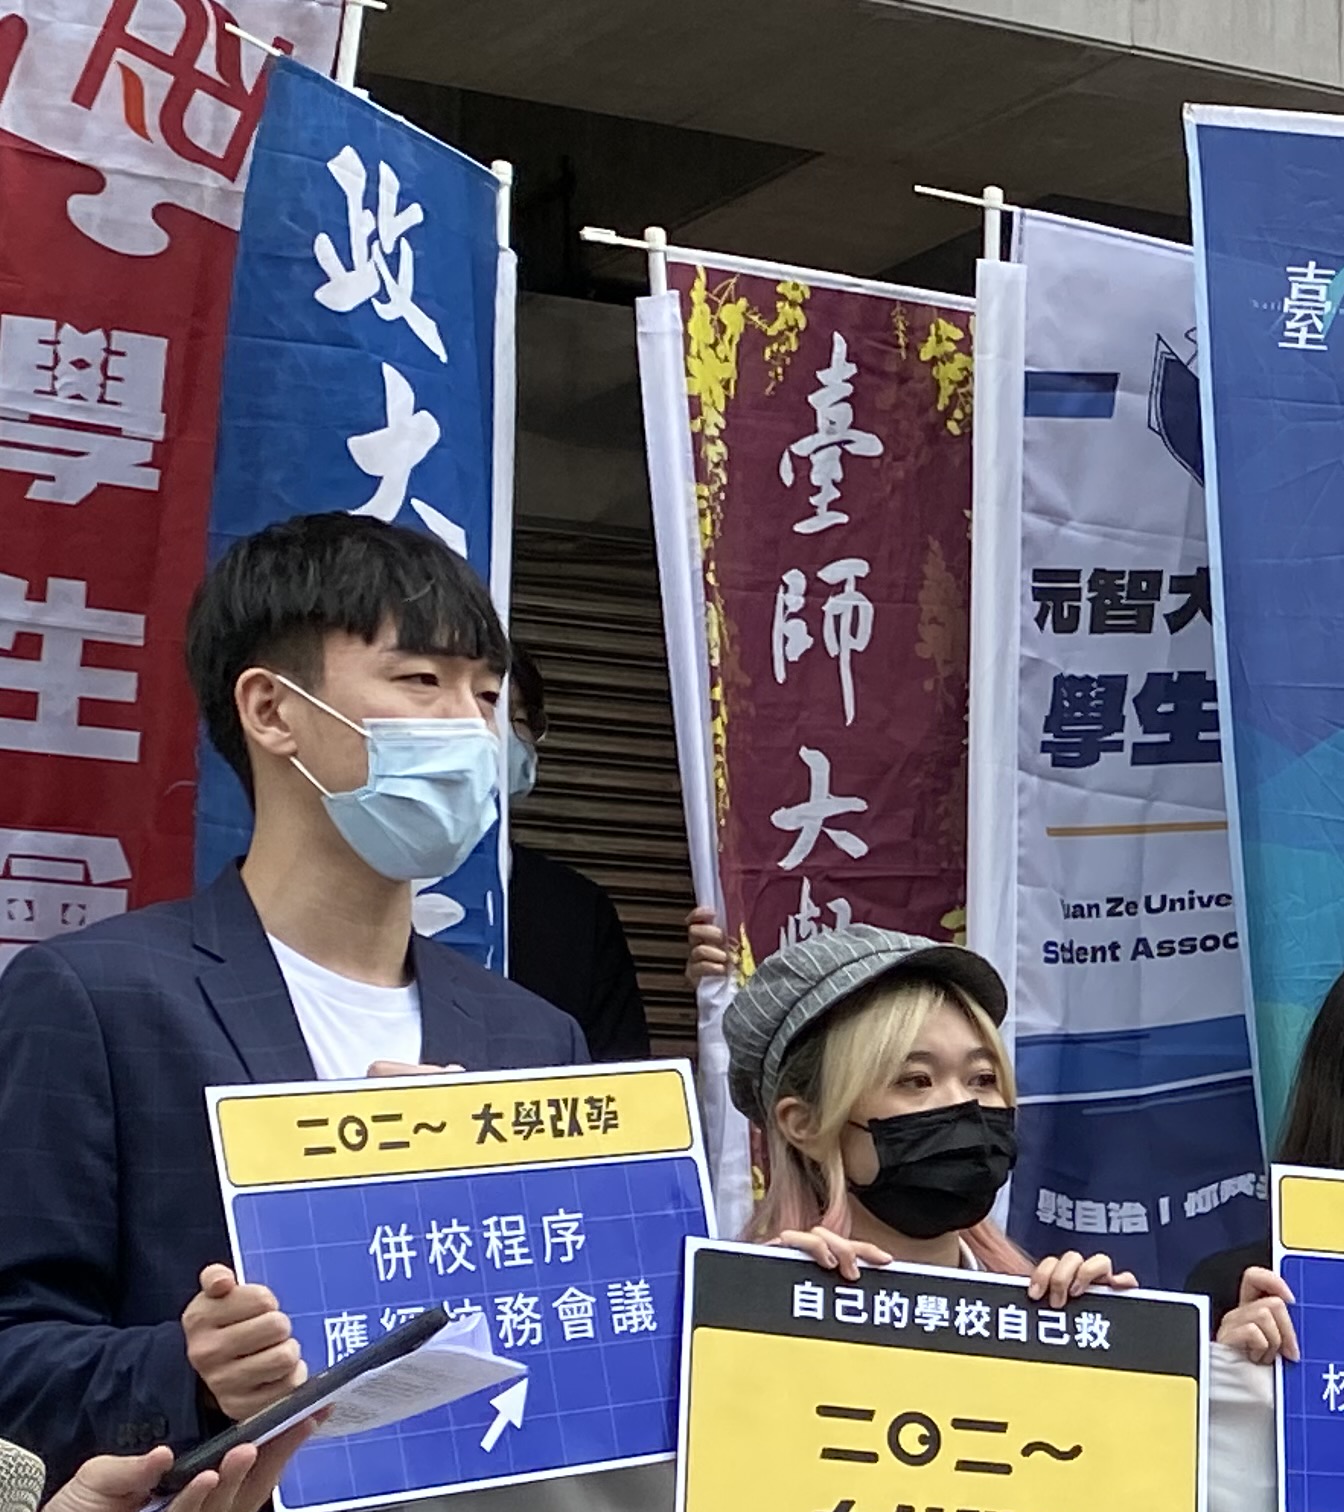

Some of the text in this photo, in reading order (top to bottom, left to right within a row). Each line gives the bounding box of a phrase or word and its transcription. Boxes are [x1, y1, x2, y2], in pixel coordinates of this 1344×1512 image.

[1106, 896, 1139, 918] Ze
[471, 1094, 619, 1145] 大學改革
[369, 1207, 587, 1283] 併校程序
[792, 1281, 1112, 1351] 自己的學校自己救
